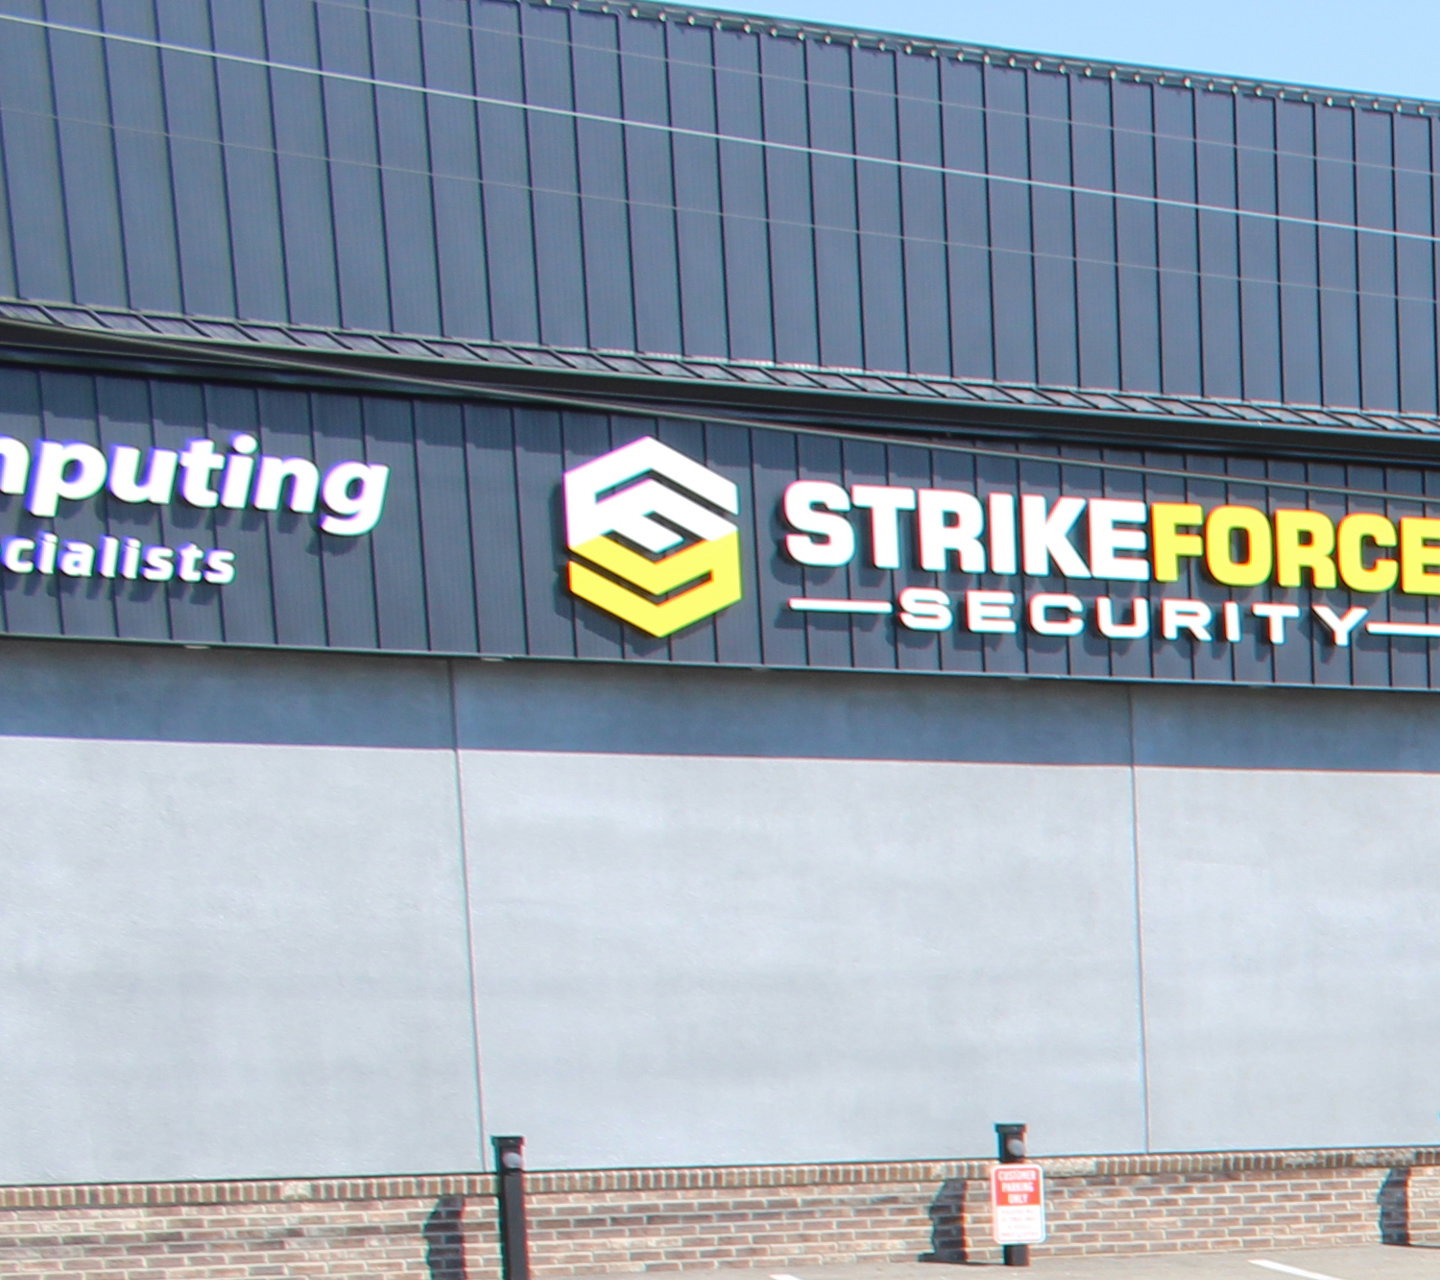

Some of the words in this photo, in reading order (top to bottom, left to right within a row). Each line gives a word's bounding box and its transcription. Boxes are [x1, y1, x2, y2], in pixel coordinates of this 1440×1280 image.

[0, 433, 390, 535] puting
[899, 587, 1369, 646] SECURITY
[1001, 1182, 1035, 1193] PARKING
